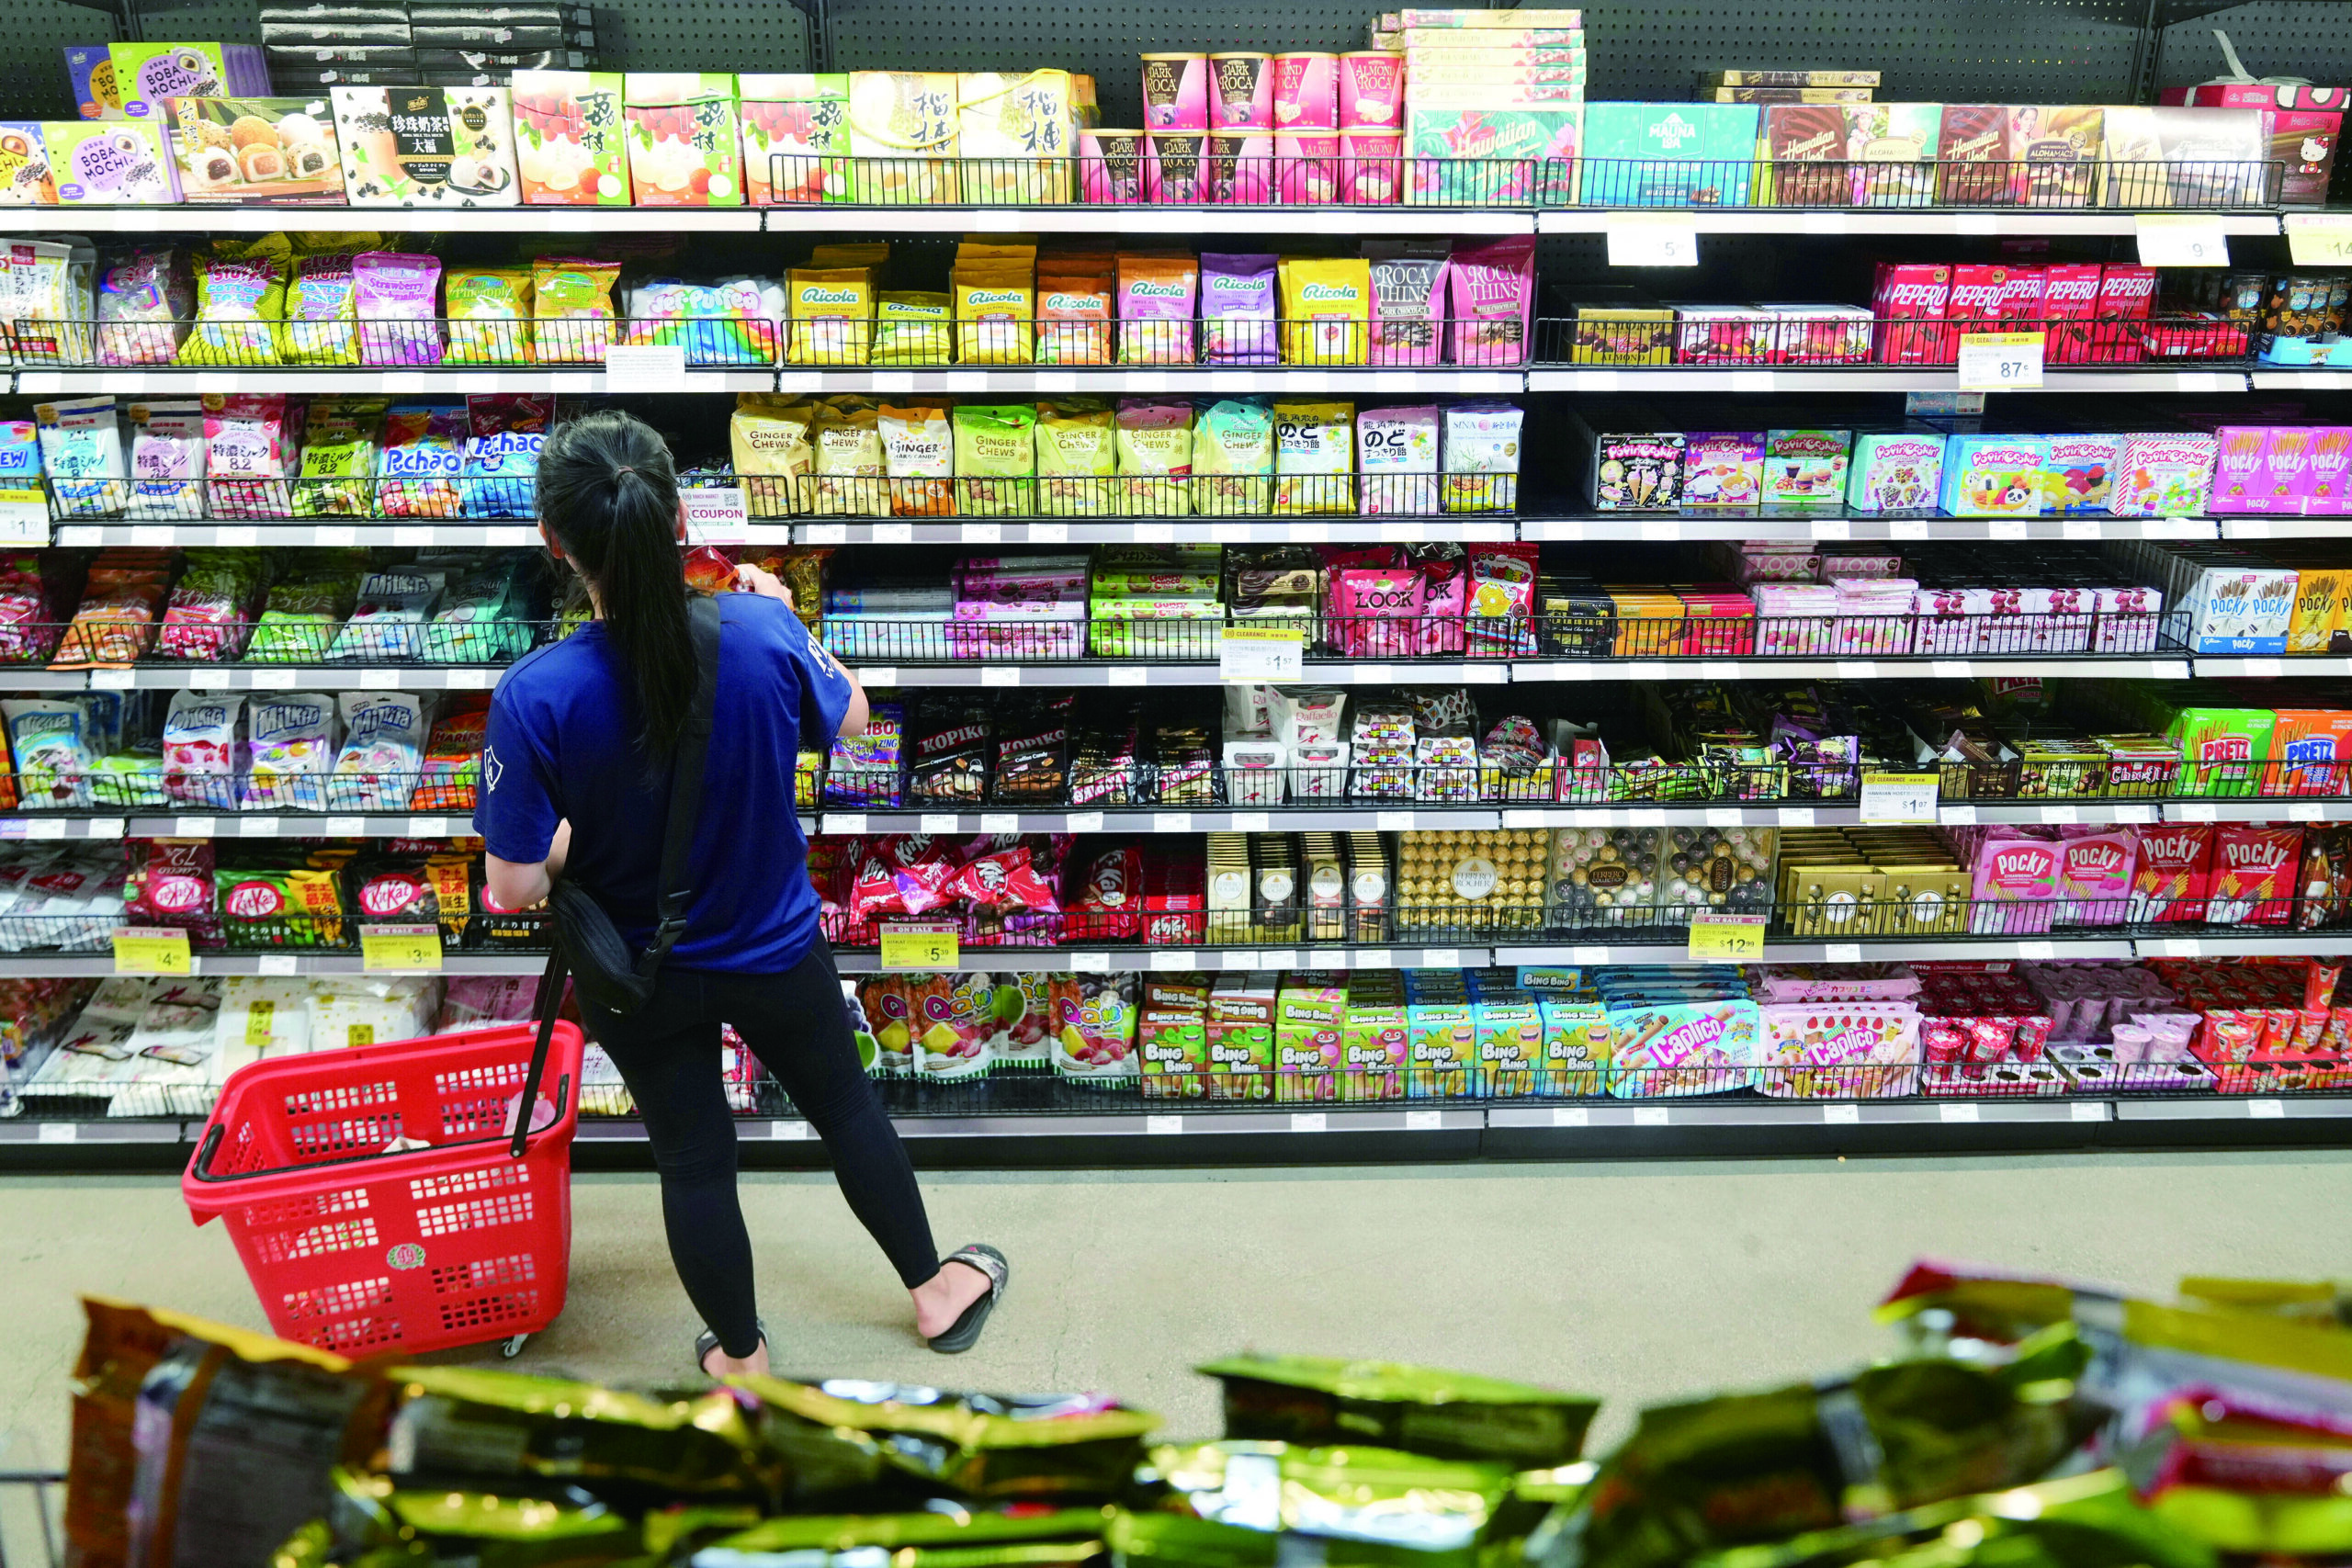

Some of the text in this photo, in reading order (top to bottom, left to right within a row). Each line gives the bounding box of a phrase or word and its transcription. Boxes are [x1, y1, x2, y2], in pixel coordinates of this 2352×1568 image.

[146, 65, 181, 85] BOBA
[1148, 66, 1172, 79] DARK
[1222, 64, 1250, 77] DARK
[1356, 64, 1396, 78] ALMOND
[148, 75, 197, 99] MOCHI.
[1146, 76, 1177, 93] ROCA
[1219, 75, 1254, 92] ROCA
[1357, 75, 1394, 92] ROCA
[391, 115, 443, 132] 珍珠奶茶
[1649, 124, 1696, 139] MAUNA
[413, 138, 437, 154] 大福
[1110, 141, 1136, 154] DARK
[1164, 141, 1192, 154] DARK
[1356, 142, 1396, 155] ALMOND
[1784, 131, 1837, 160] Hawaiian
[1947, 130, 2000, 160] Hawaiian
[80, 147, 116, 167] BOBA
[2030, 150, 2075, 159] ALOHAMACS
[84, 157, 133, 181] MOCHI.
[1376, 265, 1430, 286] ROCA
[1467, 263, 1518, 284] ROCA
[207, 284, 266, 295] COTTON
[299, 283, 349, 294] COTTON
[368, 279, 424, 293] Strawberry
[1130, 281, 1187, 299] Ricola
[1213, 276, 1267, 291] Ricola
[1468, 280, 1521, 302] THINS
[2044, 279, 2099, 301] PEPERO
[2100, 276, 2154, 299] PEPERO
[211, 293, 256, 304] TAILS
[363, 289, 428, 301] Marshmallow
[449, 286, 512, 301] Pineapple
[801, 287, 859, 304] Ricola
[967, 291, 1023, 306] Ricola
[1302, 285, 1359, 300] Ricola
[1377, 283, 1430, 303] THINS
[1891, 283, 1949, 306] PEPERO
[1950, 285, 2006, 307] PEPERO
[652, 288, 761, 313] Jet-Puffed
[1046, 294, 1102, 310] Ricola
[888, 303, 943, 315] Ricola
[1275, 412, 1319, 423] 龍角散の
[1363, 420, 1406, 430] 龍角散の
[1453, 420, 1477, 430] SINA
[750, 431, 793, 440] GINGER
[822, 428, 862, 438] GINGER
[1057, 430, 1097, 441] GINGER
[1131, 430, 1172, 440] GINGER
[1222, 430, 1262, 441] GINGER
[1277, 422, 1319, 440] のど
[1363, 429, 1407, 447] のど
[752, 439, 791, 448] CHEWS
[823, 436, 859, 447] CHEWS
[889, 441, 938, 454] GINGER
[976, 435, 1017, 447] GINGER
[1058, 439, 1096, 449] CHEWS
[1133, 438, 1170, 449] CHEWS
[1224, 439, 1260, 450] CHEWS
[1280, 439, 1320, 449] すっきり飴
[212, 444, 269, 458] 特濃ミルク
[306, 450, 355, 465] 特濃ミルク
[977, 446, 1015, 457] CHEWS
[1363, 447, 1408, 457] すっきり飴
[229, 457, 252, 470] 8.2
[317, 462, 337, 474] 8.2
[385, 448, 462, 474] Puchao
[2221, 453, 2261, 473] POCKY
[2267, 453, 2308, 473] POCKY
[2310, 452, 2350, 472] POCKY
[692, 508, 743, 520] COUPON
[1758, 558, 1808, 572] LOOK
[1838, 558, 1889, 572] LOOK
[1020, 581, 1055, 592] GUMMY
[1354, 591, 1414, 609] LOOK
[2211, 597, 2249, 615] POCKY
[2252, 597, 2291, 616] POCKY
[2299, 596, 2336, 614] POCKY
[1295, 711, 1338, 722] Raffaello
[922, 724, 991, 753] KOPIKO
[1000, 729, 1065, 755] KOPIKO
[1014, 751, 1048, 762] Coffee Candy
[2203, 739, 2251, 762] PRETZ
[2288, 740, 2334, 762] PRETZ
[2068, 844, 2120, 869] POCKY
[2143, 835, 2199, 863] POCKY
[2226, 840, 2289, 868] POCKY
[1996, 851, 2047, 874] POCKY
[1714, 859, 1723, 891] FERRERO
[1455, 879, 1491, 887] ROCHER
[233, 886, 277, 911] KitKat
[369, 883, 413, 910] KitKat
[1524, 974, 1570, 987] BING BING
[1830, 985, 1872, 994] カプリコミニ
[1653, 1019, 1722, 1066] Caplico
[1810, 1029, 1874, 1069] Caplico
[1145, 1044, 1183, 1061] BING
[1212, 1044, 1250, 1062] BING
[1282, 1047, 1320, 1065] BING
[1349, 1046, 1386, 1064] BING
[1415, 1043, 1453, 1061] BING
[1481, 1043, 1519, 1060] BING
[1549, 1042, 1587, 1059] BING
[1164, 1059, 1193, 1073] BING
[1231, 1060, 1260, 1073] BING
[1301, 1063, 1329, 1076] BING
[1367, 1063, 1396, 1074] BING
[1432, 1058, 1461, 1071] BING
[1500, 1058, 1528, 1070] BING
[1567, 1057, 1595, 1070] BING
